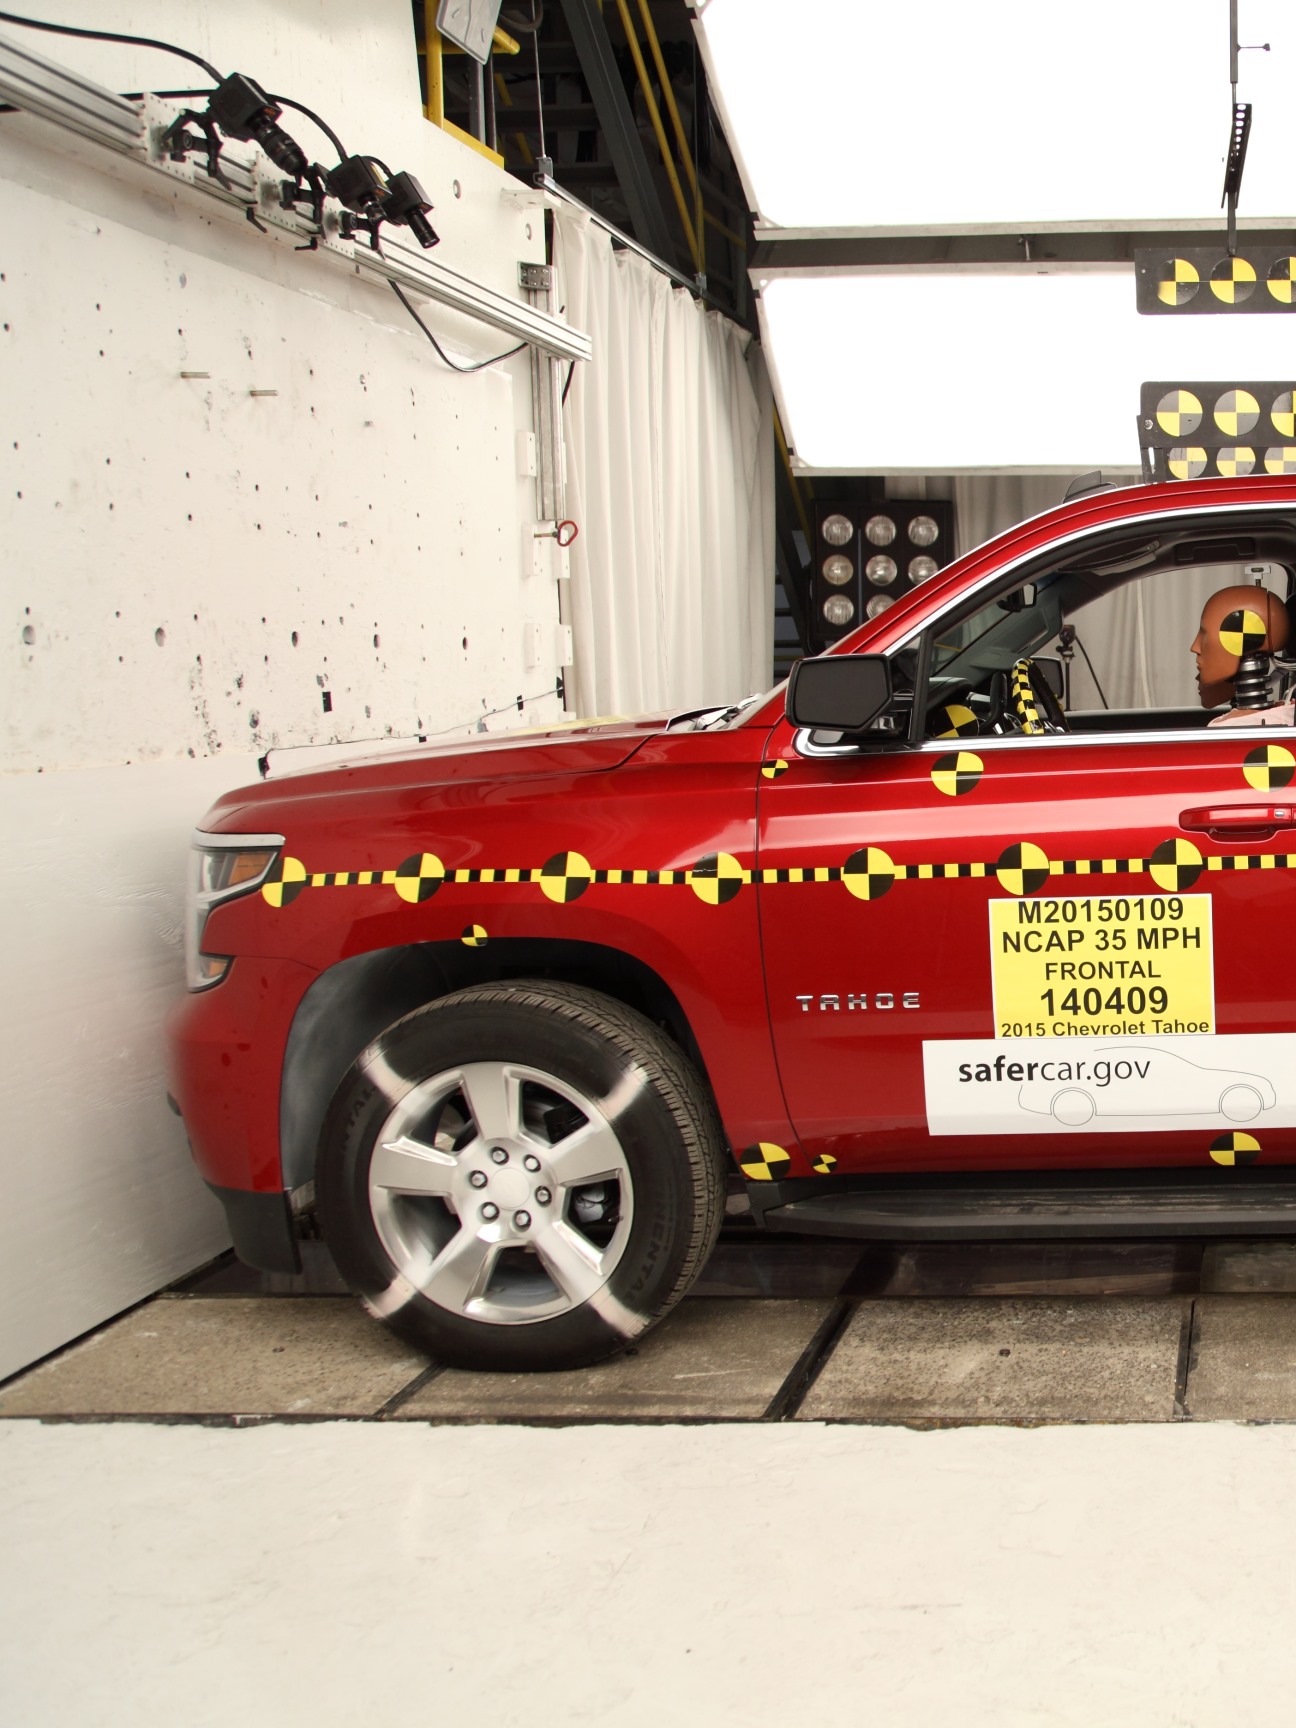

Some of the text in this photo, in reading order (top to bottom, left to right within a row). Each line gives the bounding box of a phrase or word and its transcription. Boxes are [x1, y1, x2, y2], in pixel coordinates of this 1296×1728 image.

[1018, 897, 1184, 924] M20150109
[1002, 927, 1202, 953] NCAP 35 MPH
[1045, 961, 1162, 981] FRONTAL
[795, 992, 921, 1012] TAHOE
[1041, 985, 1169, 1017] 140409
[1001, 1019, 1210, 1038] 2015 Chevrolet Tahoe
[958, 1055, 1151, 1087] safercar.gov
